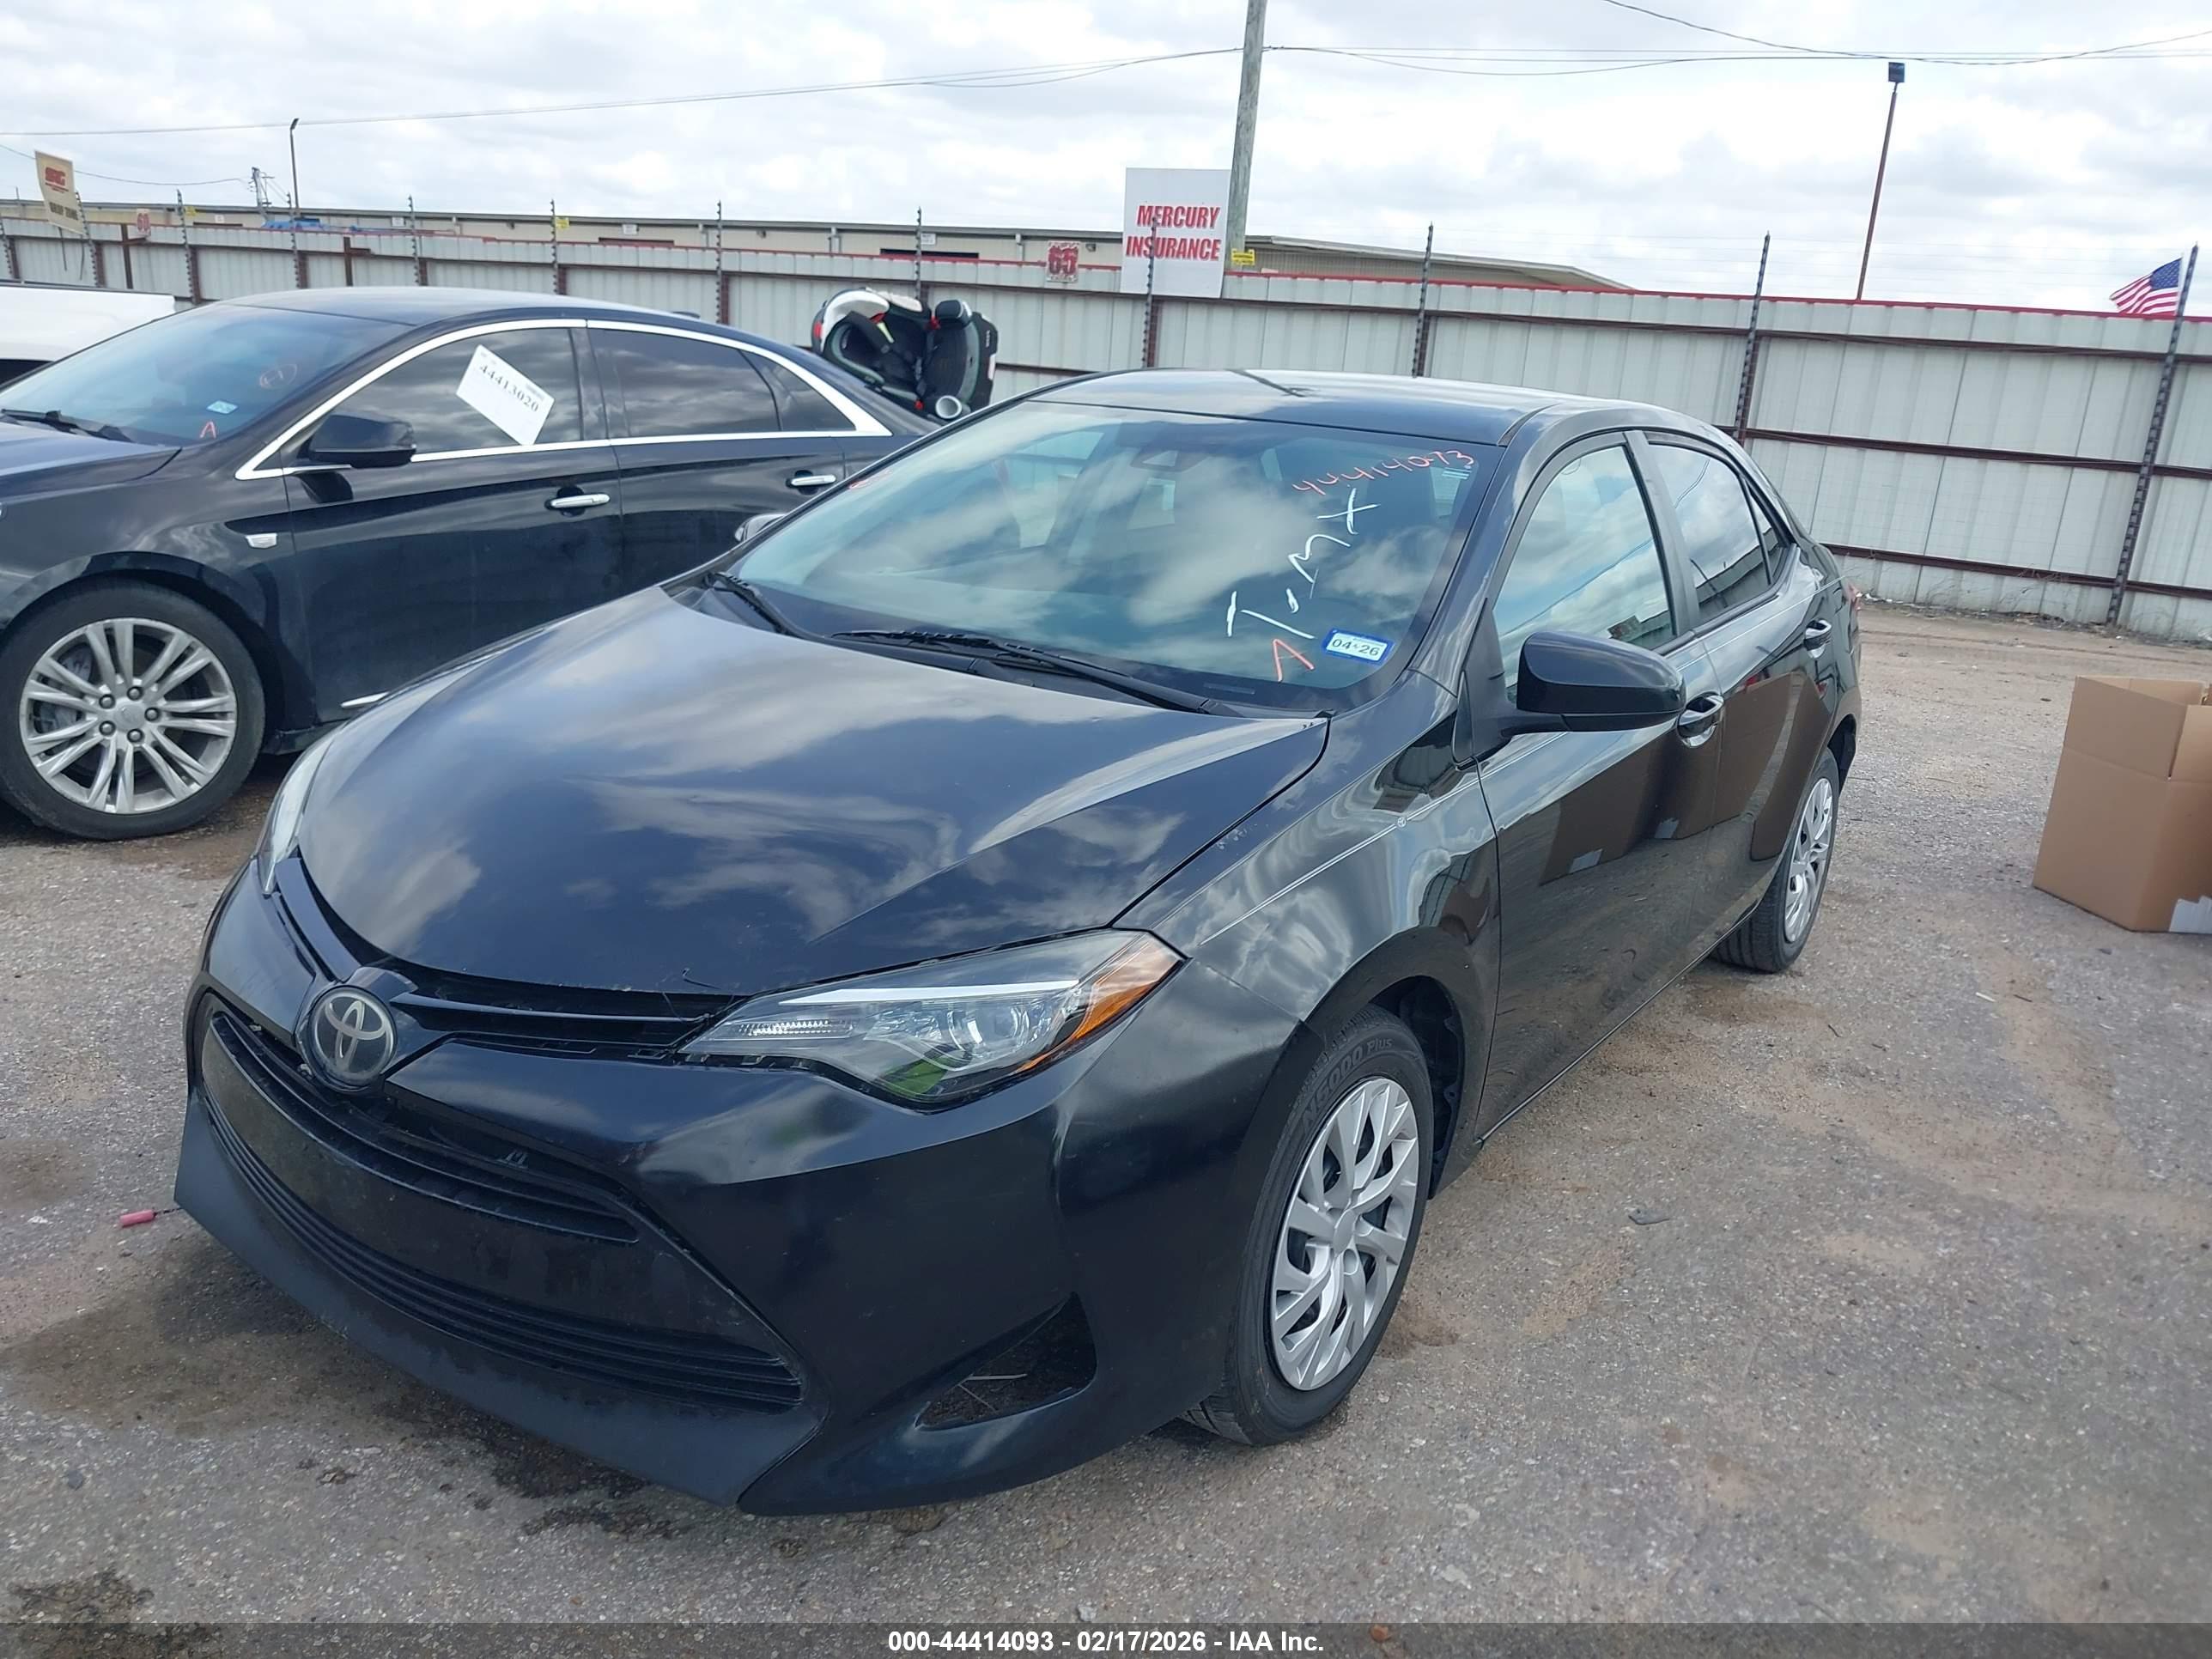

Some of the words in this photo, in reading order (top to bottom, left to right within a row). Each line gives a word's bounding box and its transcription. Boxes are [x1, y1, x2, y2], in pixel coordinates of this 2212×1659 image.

[1137, 205, 1220, 229] MERCURY
[1126, 236, 1222, 261] INSURANCE
[479, 364, 539, 411] 44413020
